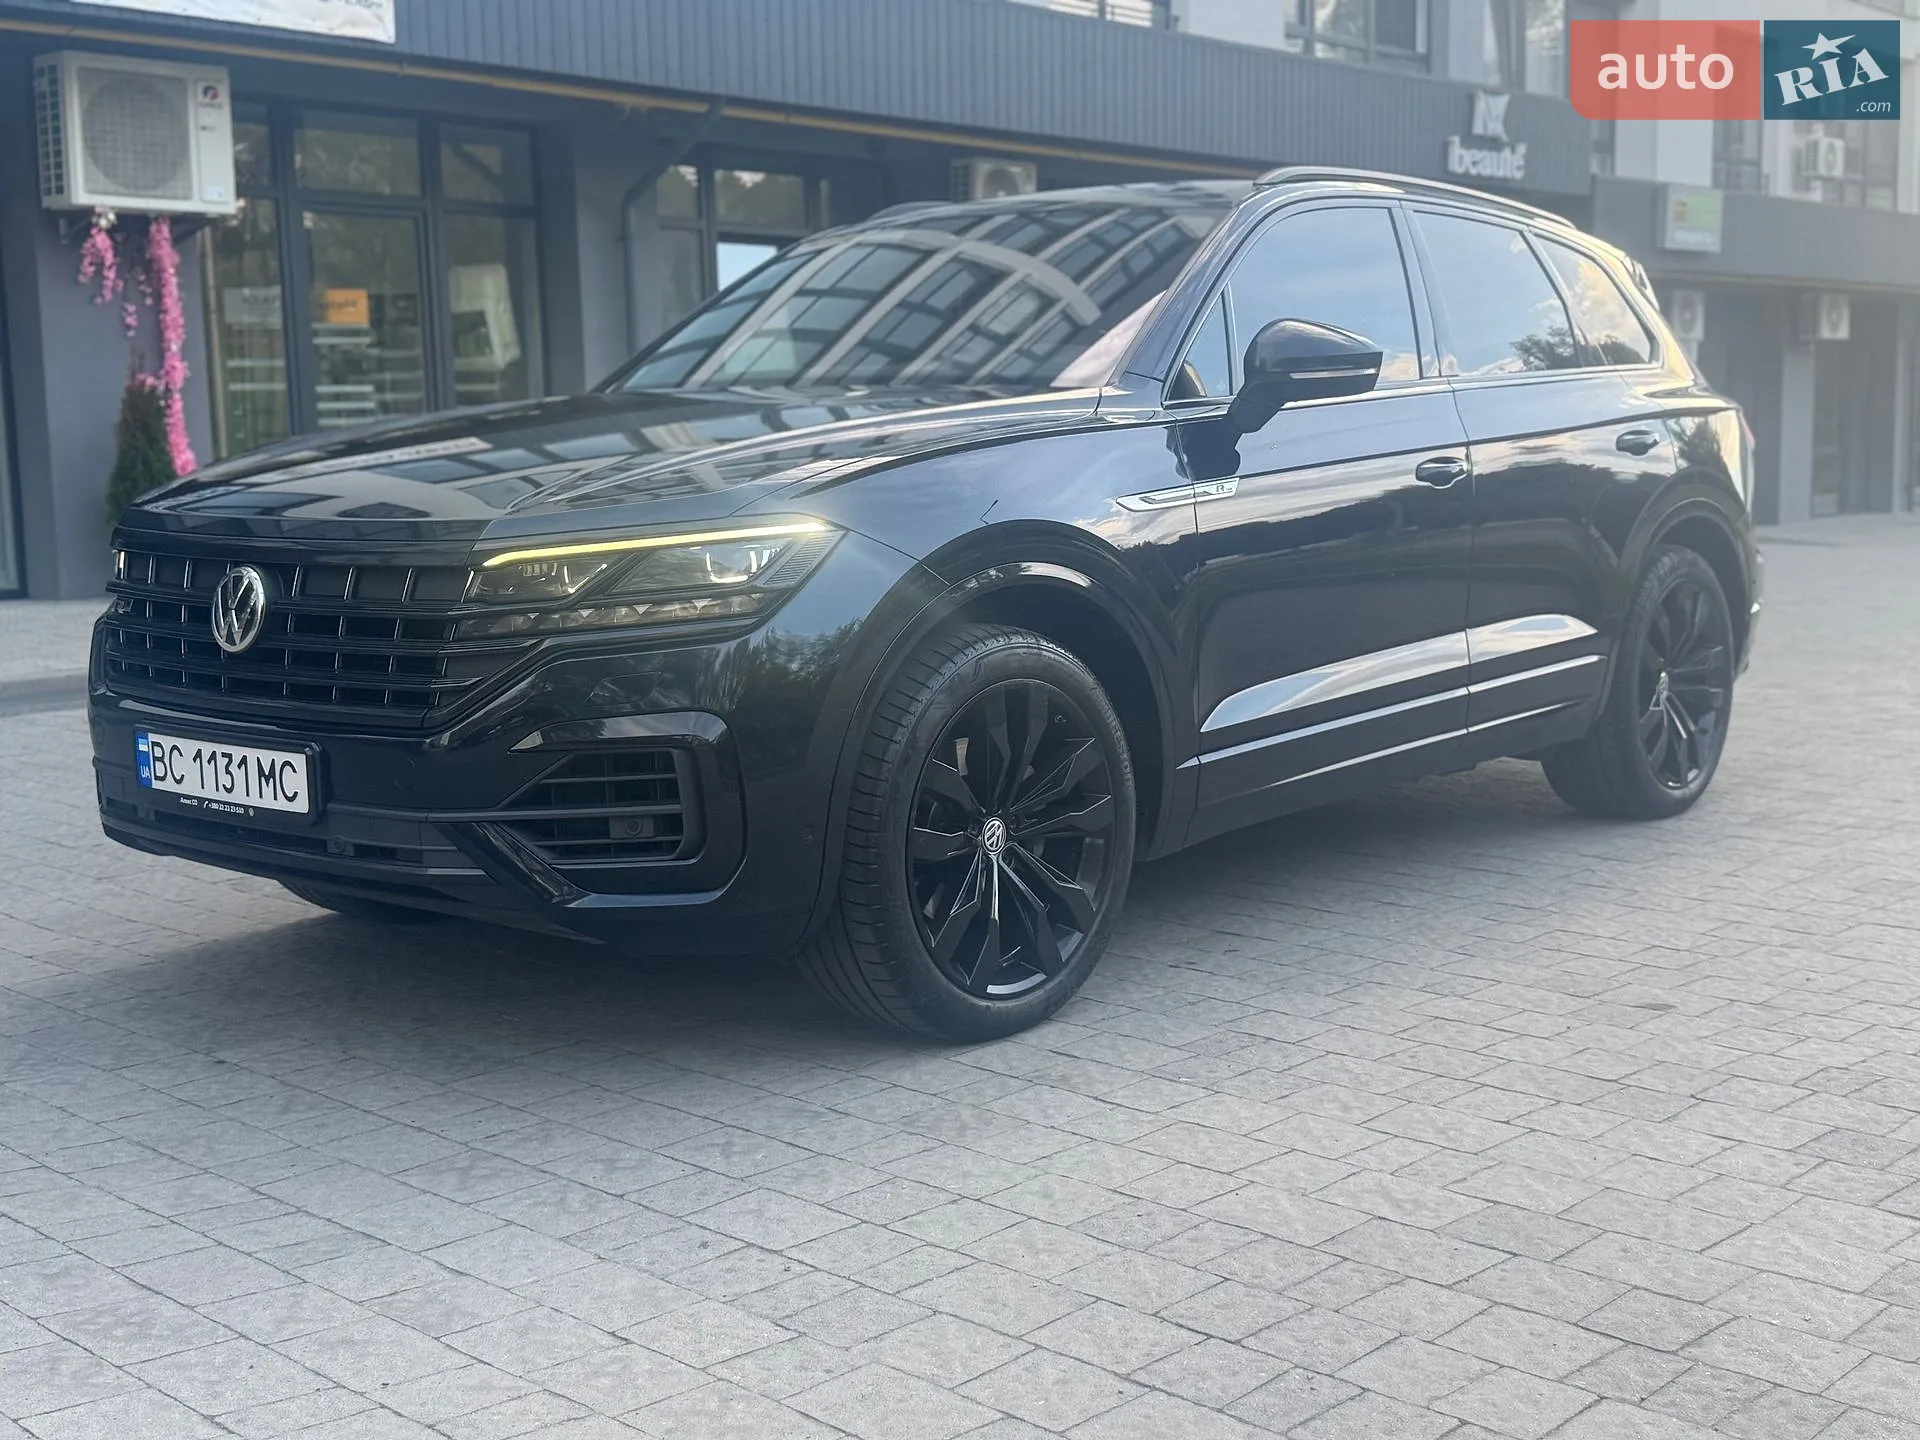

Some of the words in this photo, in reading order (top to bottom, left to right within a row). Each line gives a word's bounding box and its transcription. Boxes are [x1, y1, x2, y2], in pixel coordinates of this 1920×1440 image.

[140, 765, 151, 778] UA
[151, 740, 185, 785] BC
[192, 748, 250, 797] 1131
[256, 755, 299, 804] MC
